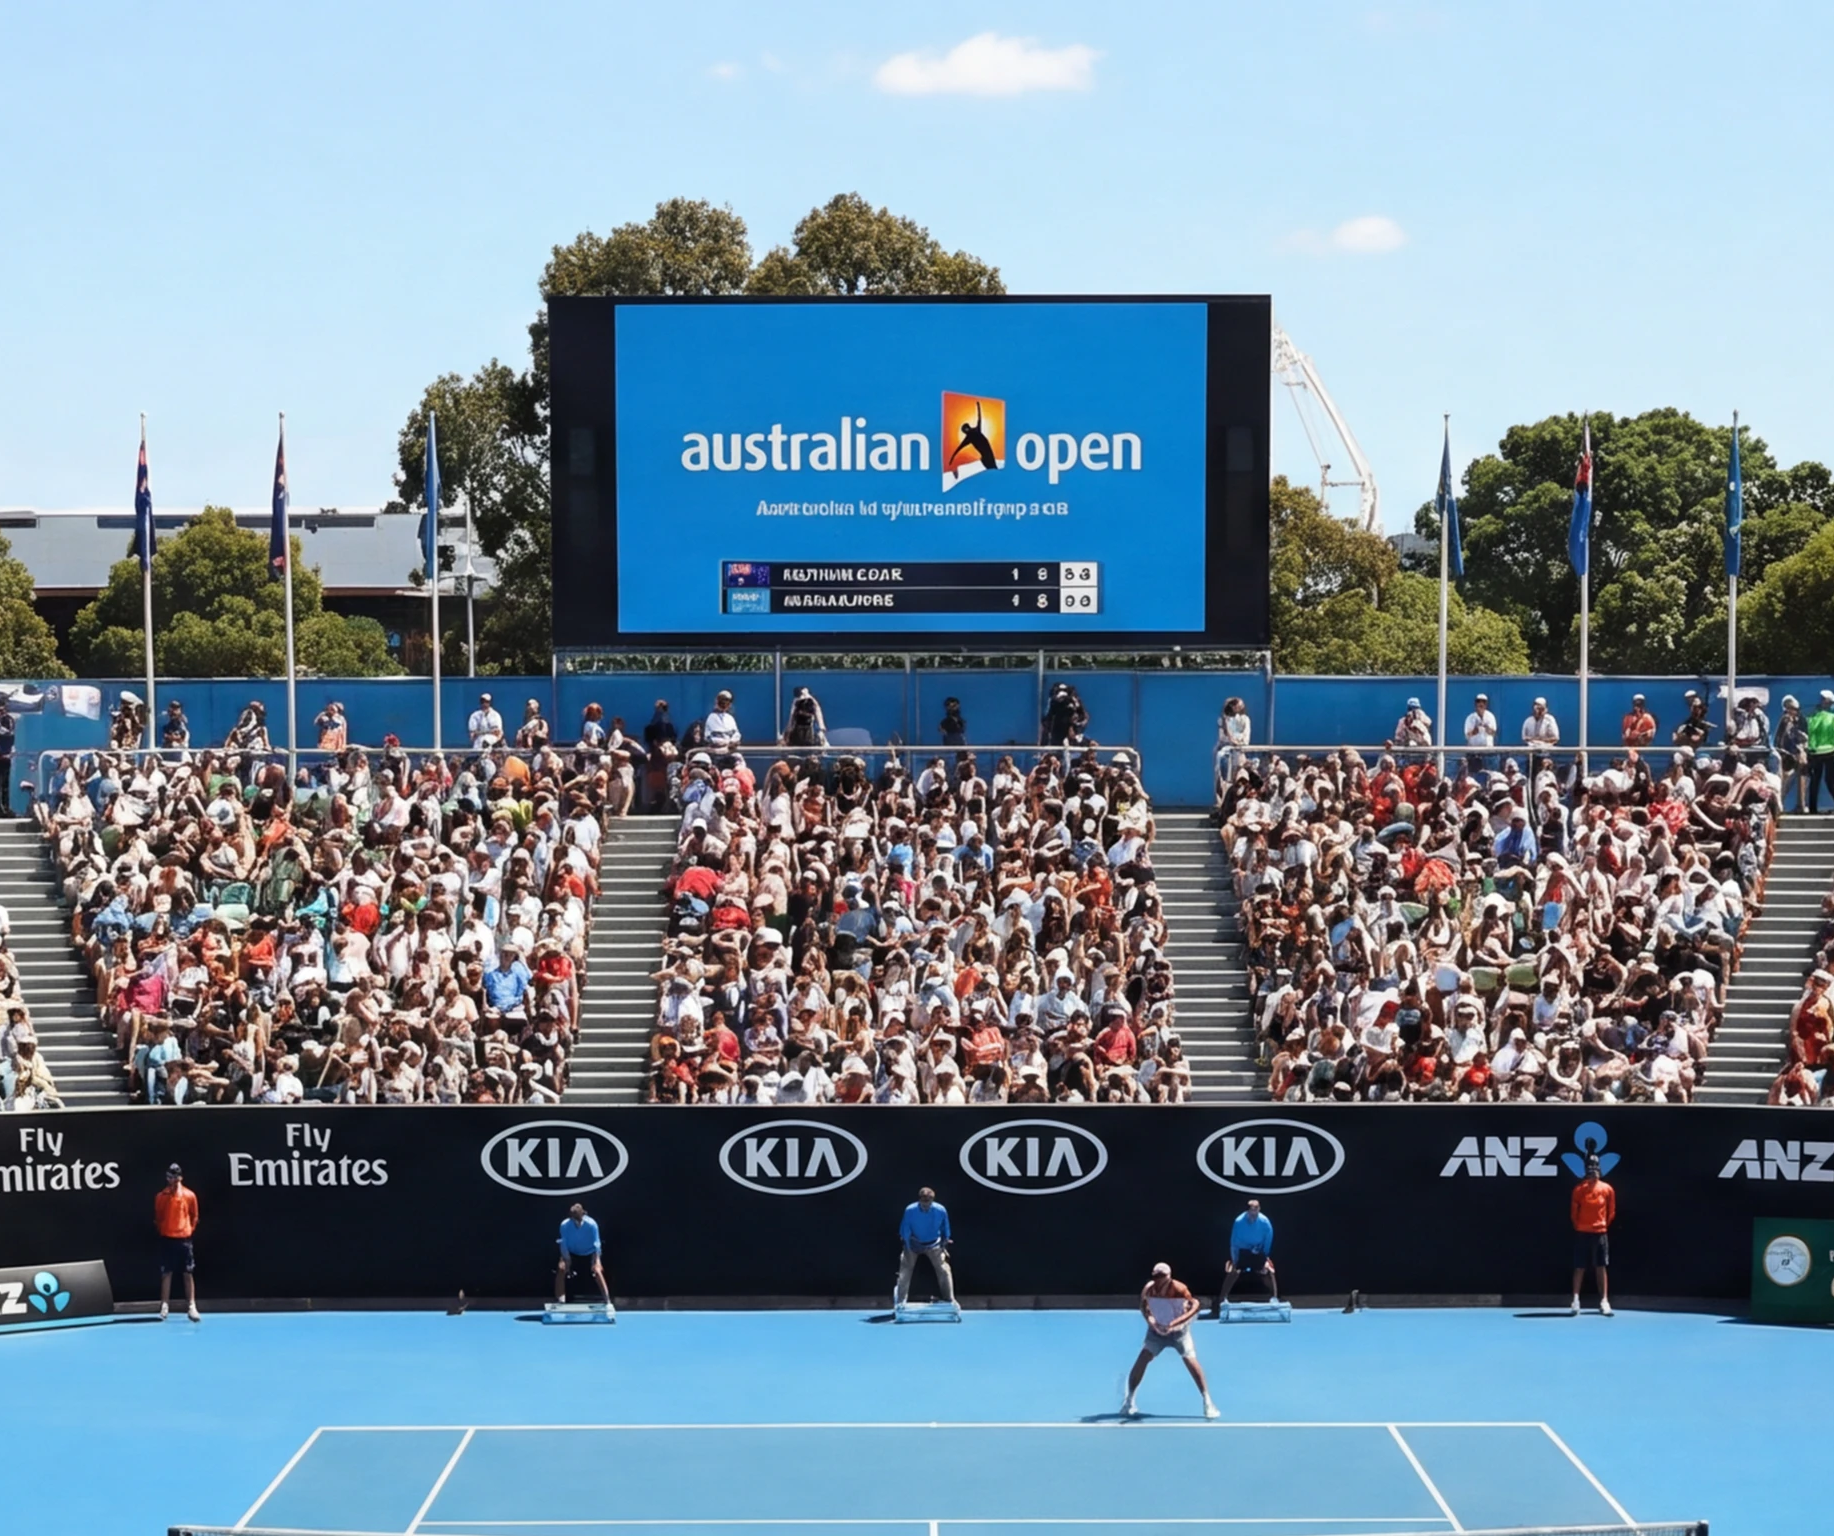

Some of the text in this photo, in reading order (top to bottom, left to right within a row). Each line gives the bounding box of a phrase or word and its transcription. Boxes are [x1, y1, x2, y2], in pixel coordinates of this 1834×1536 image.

[681, 416, 1142, 485] australian open
[19, 1127, 64, 1157] Fly
[285, 1122, 331, 1153] Fly
[506, 1137, 605, 1178] KIA
[744, 1137, 843, 1178] KIA
[985, 1136, 1083, 1178] KIA
[1221, 1136, 1321, 1177] KIA
[1439, 1136, 1558, 1177] ANZ
[228, 1152, 389, 1187] Emirates
